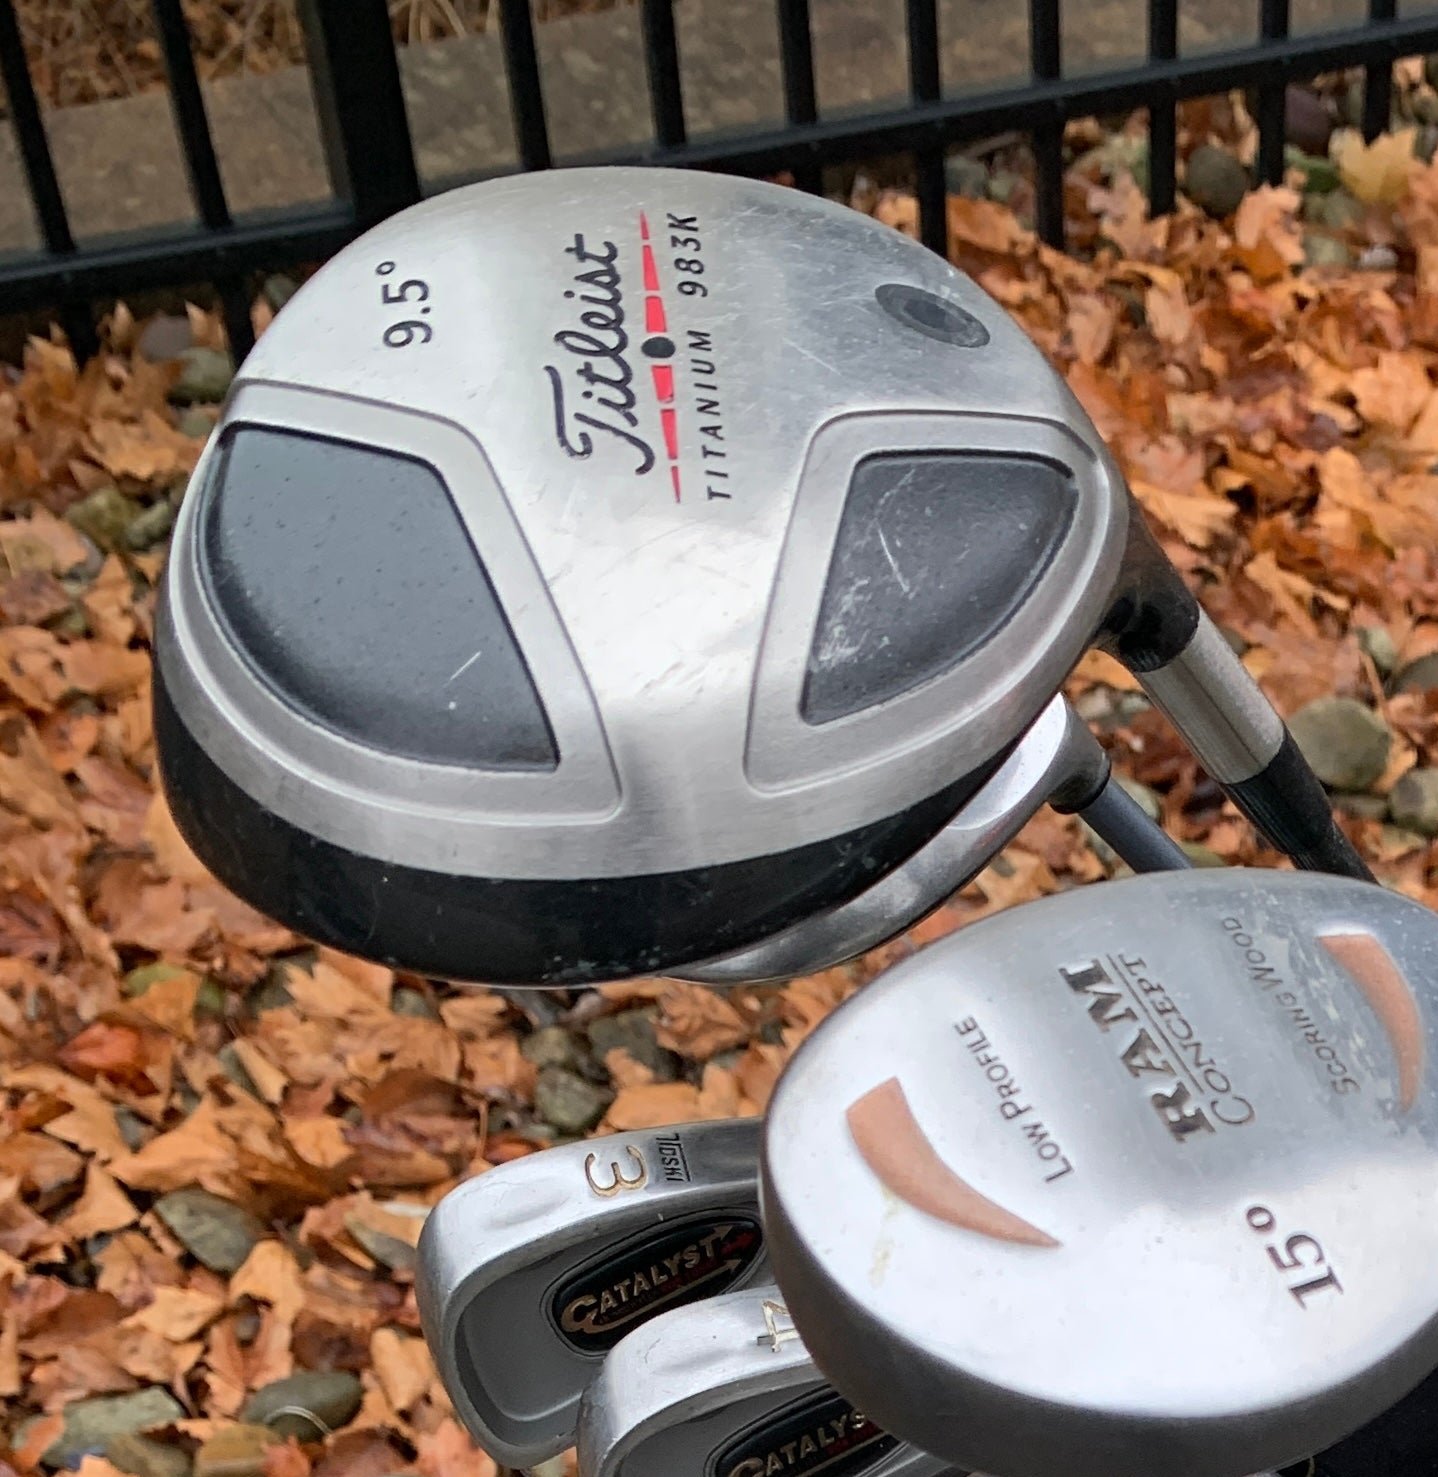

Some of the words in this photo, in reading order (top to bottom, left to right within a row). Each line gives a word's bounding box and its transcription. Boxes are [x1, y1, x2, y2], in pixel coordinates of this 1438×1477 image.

[666, 212, 709, 298] 983K
[544, 232, 656, 476] Titleist
[686, 330, 732, 500] TITANIUM
[1221, 916, 1284, 991] WOOD
[953, 1015, 1033, 1121] PROFILE
[1057, 958, 1217, 1144] RAM
[1117, 953, 1256, 1126] CONCEPT
[1275, 991, 1361, 1095] SCORING
[585, 1143, 649, 1198] 3
[655, 1132, 693, 1183] TOSKI
[1021, 1121, 1075, 1183] LOW
[560, 1224, 734, 1335] CATALYST
